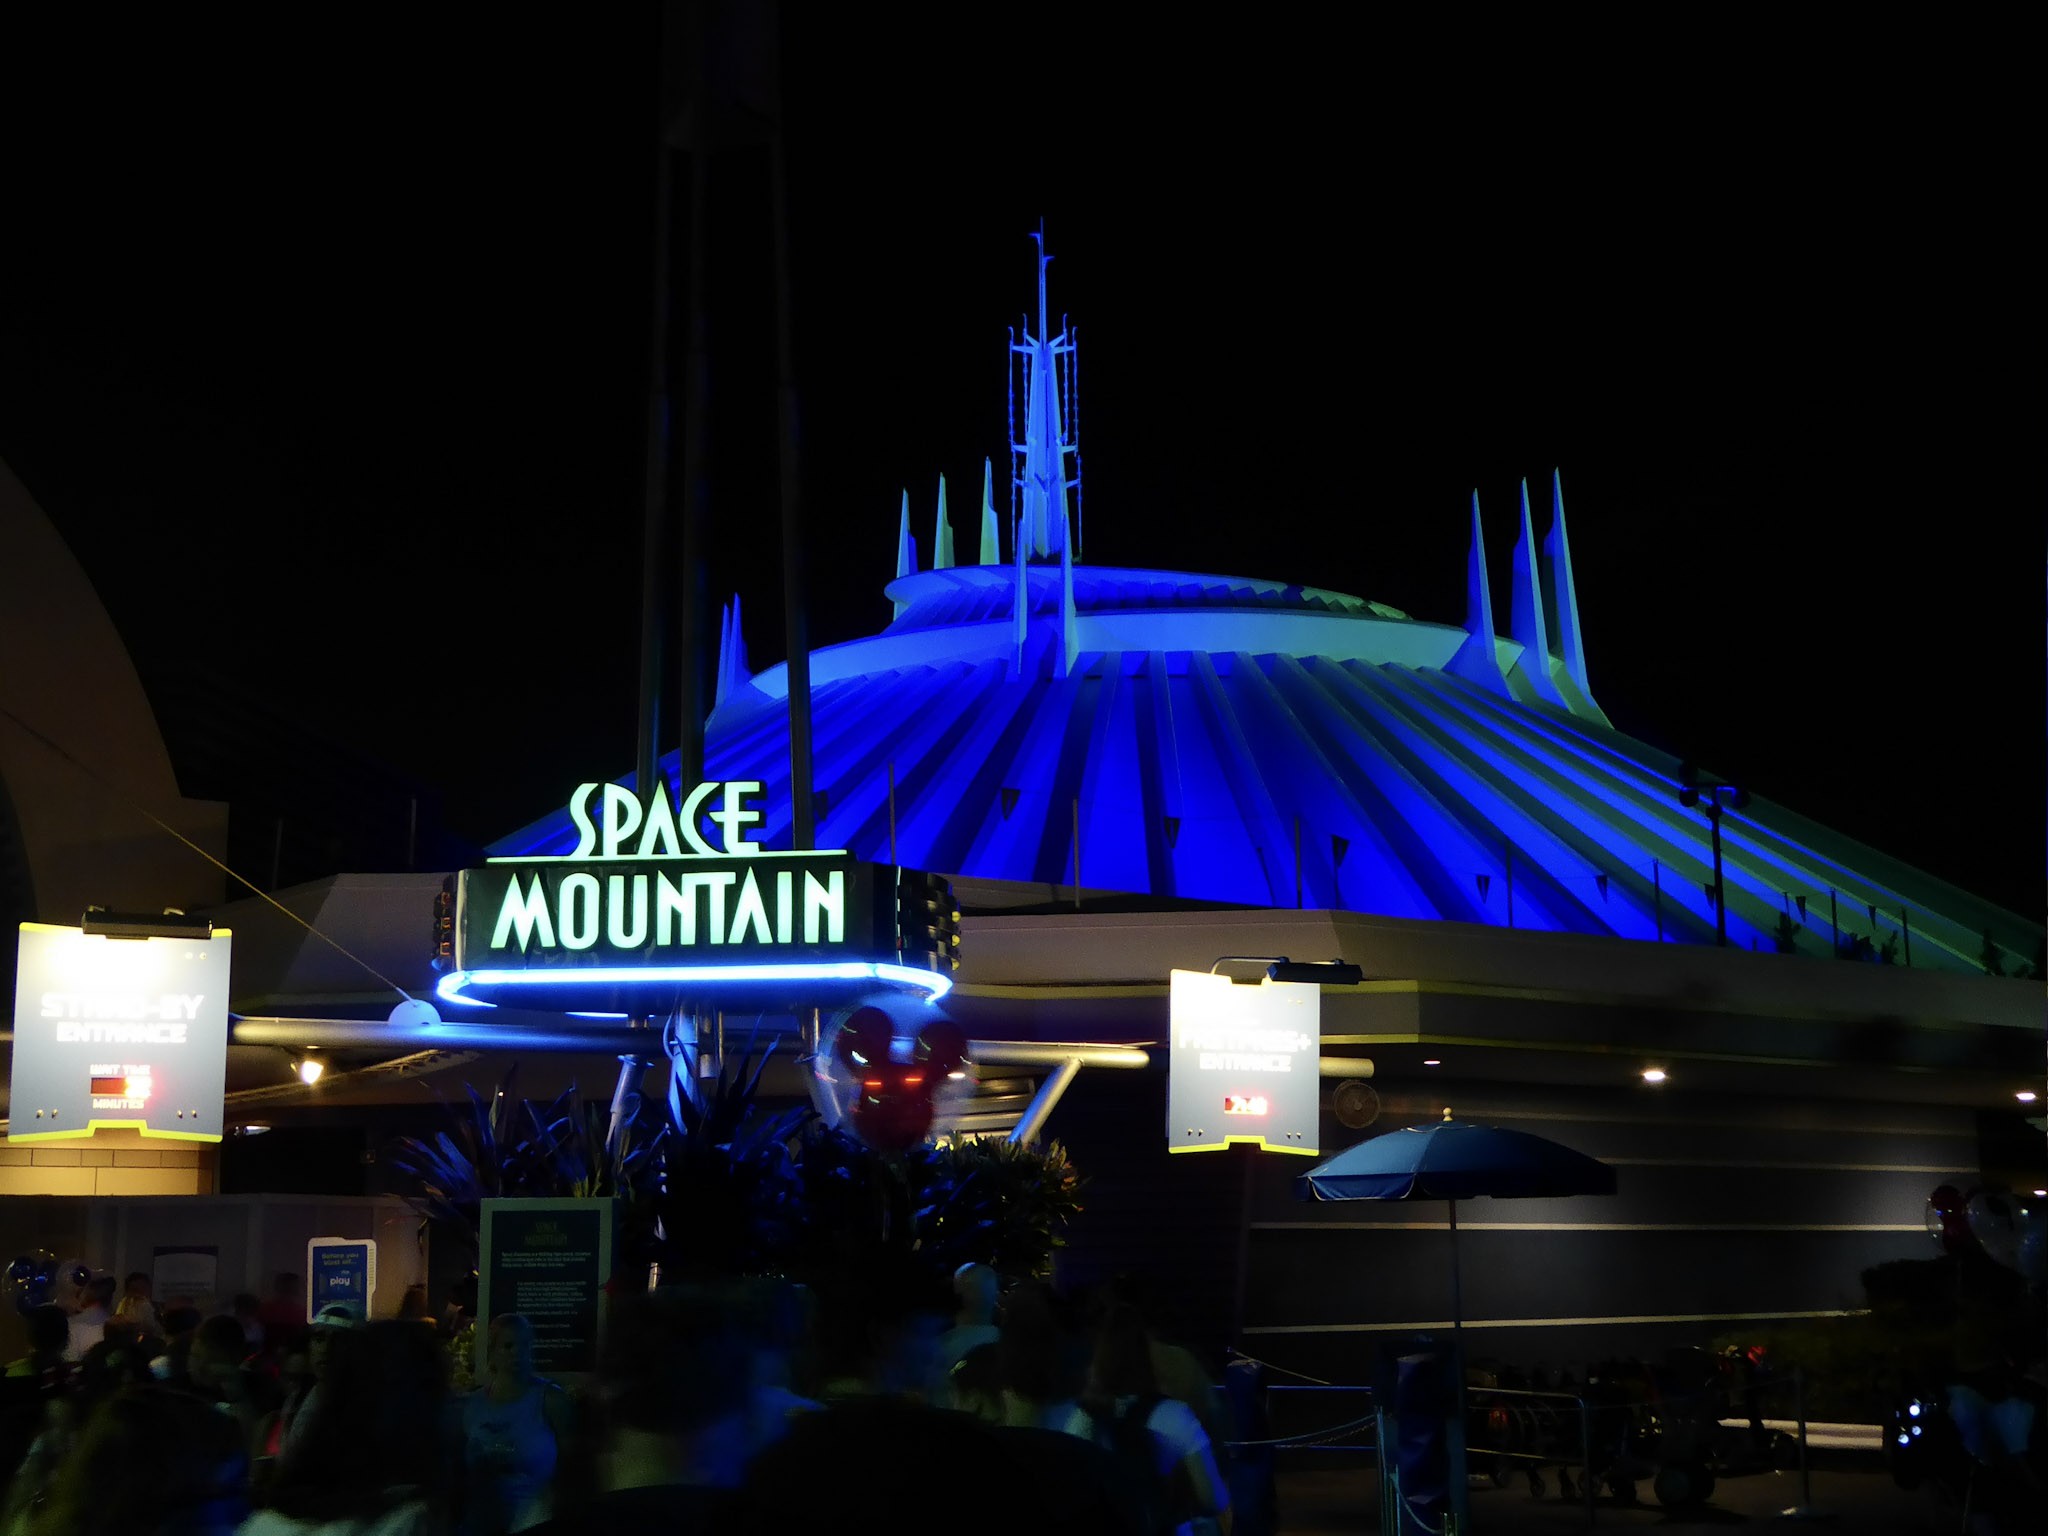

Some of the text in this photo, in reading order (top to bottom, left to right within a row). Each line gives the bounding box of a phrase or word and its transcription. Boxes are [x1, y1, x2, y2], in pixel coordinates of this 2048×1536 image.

[570, 780, 760, 857] SPACE
[491, 866, 844, 954] MOUNTAIN
[57, 1021, 187, 1043] ENTRANCE
[1199, 1053, 1291, 1072] ENTRANCE
[93, 1098, 145, 1109] MINUTES
[329, 1276, 351, 1287] play
